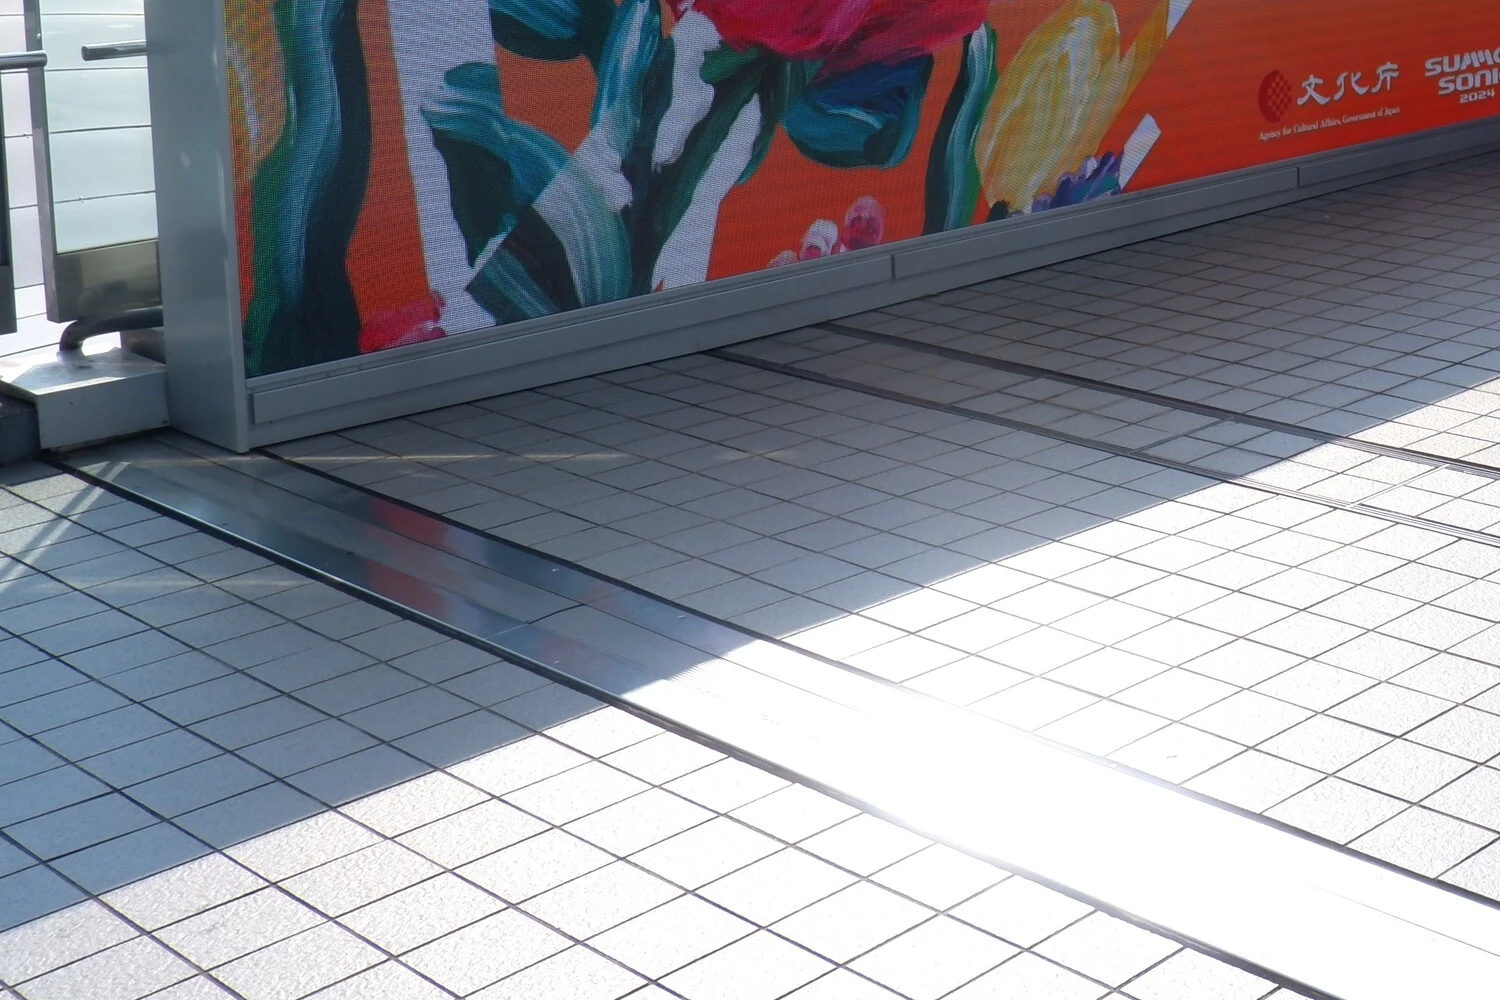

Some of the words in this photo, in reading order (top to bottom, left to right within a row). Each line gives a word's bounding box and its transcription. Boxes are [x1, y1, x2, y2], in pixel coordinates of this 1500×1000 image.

[1296, 60, 1400, 107] 文化庁
[1459, 88, 1496, 104] 2024
[1282, 126, 1292, 136] for
[1377, 108, 1384, 118] of
